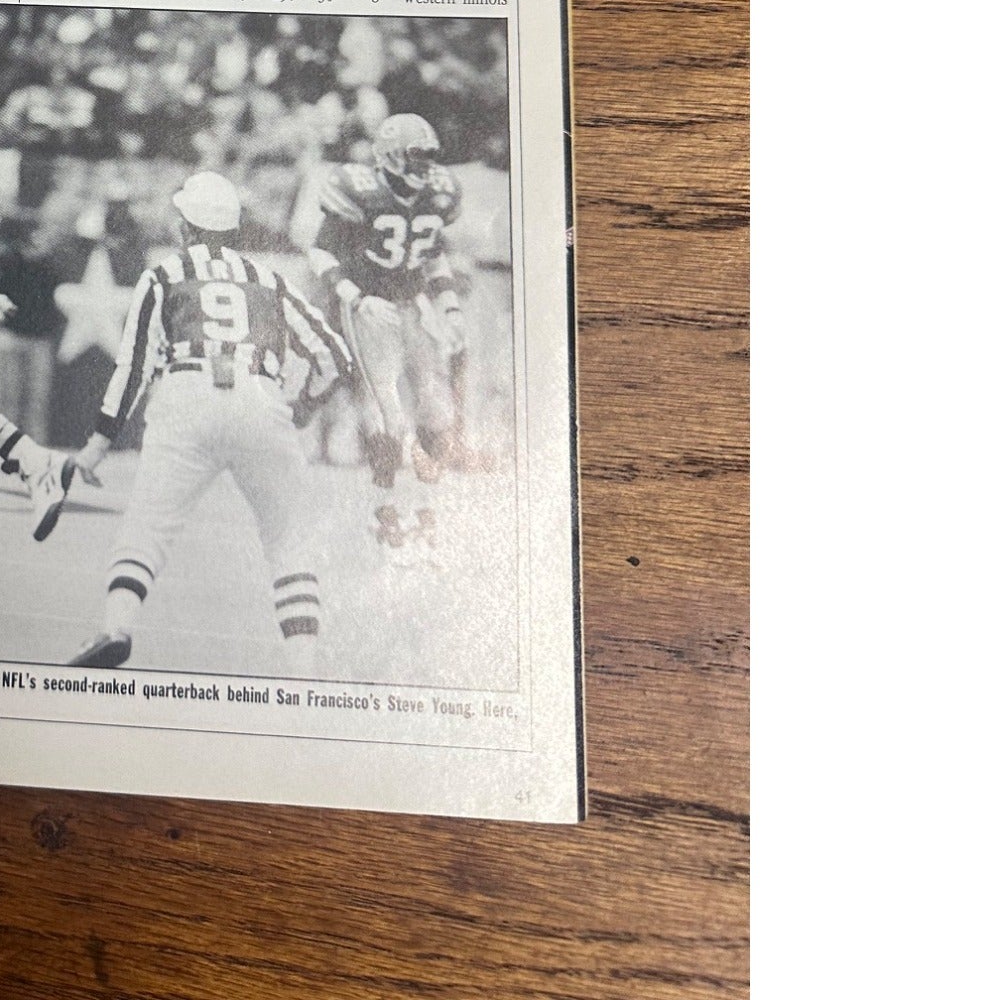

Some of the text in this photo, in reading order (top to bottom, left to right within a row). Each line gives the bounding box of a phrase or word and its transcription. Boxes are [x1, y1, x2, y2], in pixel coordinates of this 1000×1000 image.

[365, 214, 444, 270] 32
[200, 281, 250, 341] 9
[2, 671, 36, 689] NFL's
[43, 677, 135, 695] second-ranked
[143, 683, 219, 701] quarterback
[227, 685, 269, 703] behind
[276, 688, 300, 706] San
[307, 690, 380, 711] Francisco's
[387, 694, 424, 713] Steve
[433, 697, 475, 719] Young.
